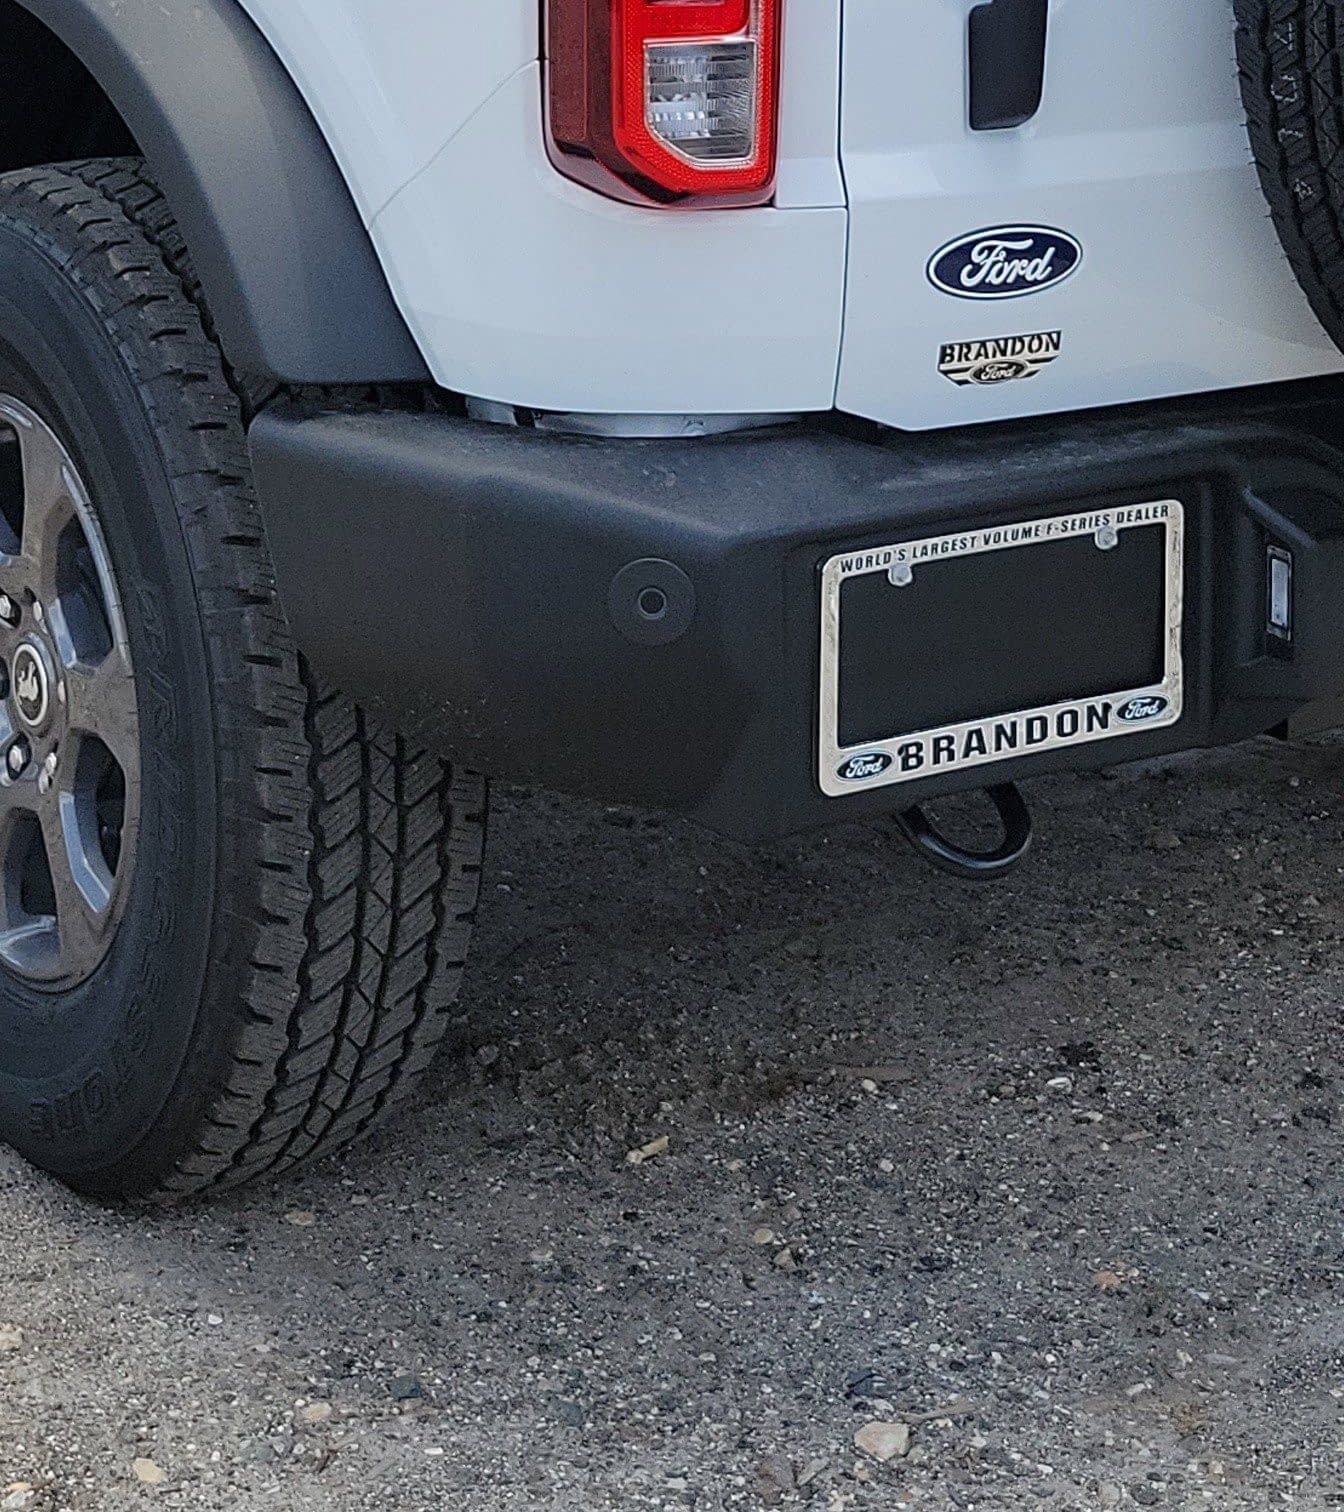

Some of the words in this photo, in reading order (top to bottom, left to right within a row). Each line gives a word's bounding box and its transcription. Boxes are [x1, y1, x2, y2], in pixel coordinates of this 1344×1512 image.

[960, 238, 1056, 288] Ford
[941, 331, 1062, 364] BRANDON
[980, 363, 1017, 381] Ford
[840, 548, 907, 573] WORLD'S
[912, 535, 977, 559] LARGEST
[983, 524, 1041, 546] VOLUME
[1046, 513, 1111, 536] F-SERIES
[1116, 504, 1169, 524] DEALER
[845, 754, 884, 779] Ford
[897, 701, 1113, 772] BRANDON
[1124, 697, 1161, 720] Ford
